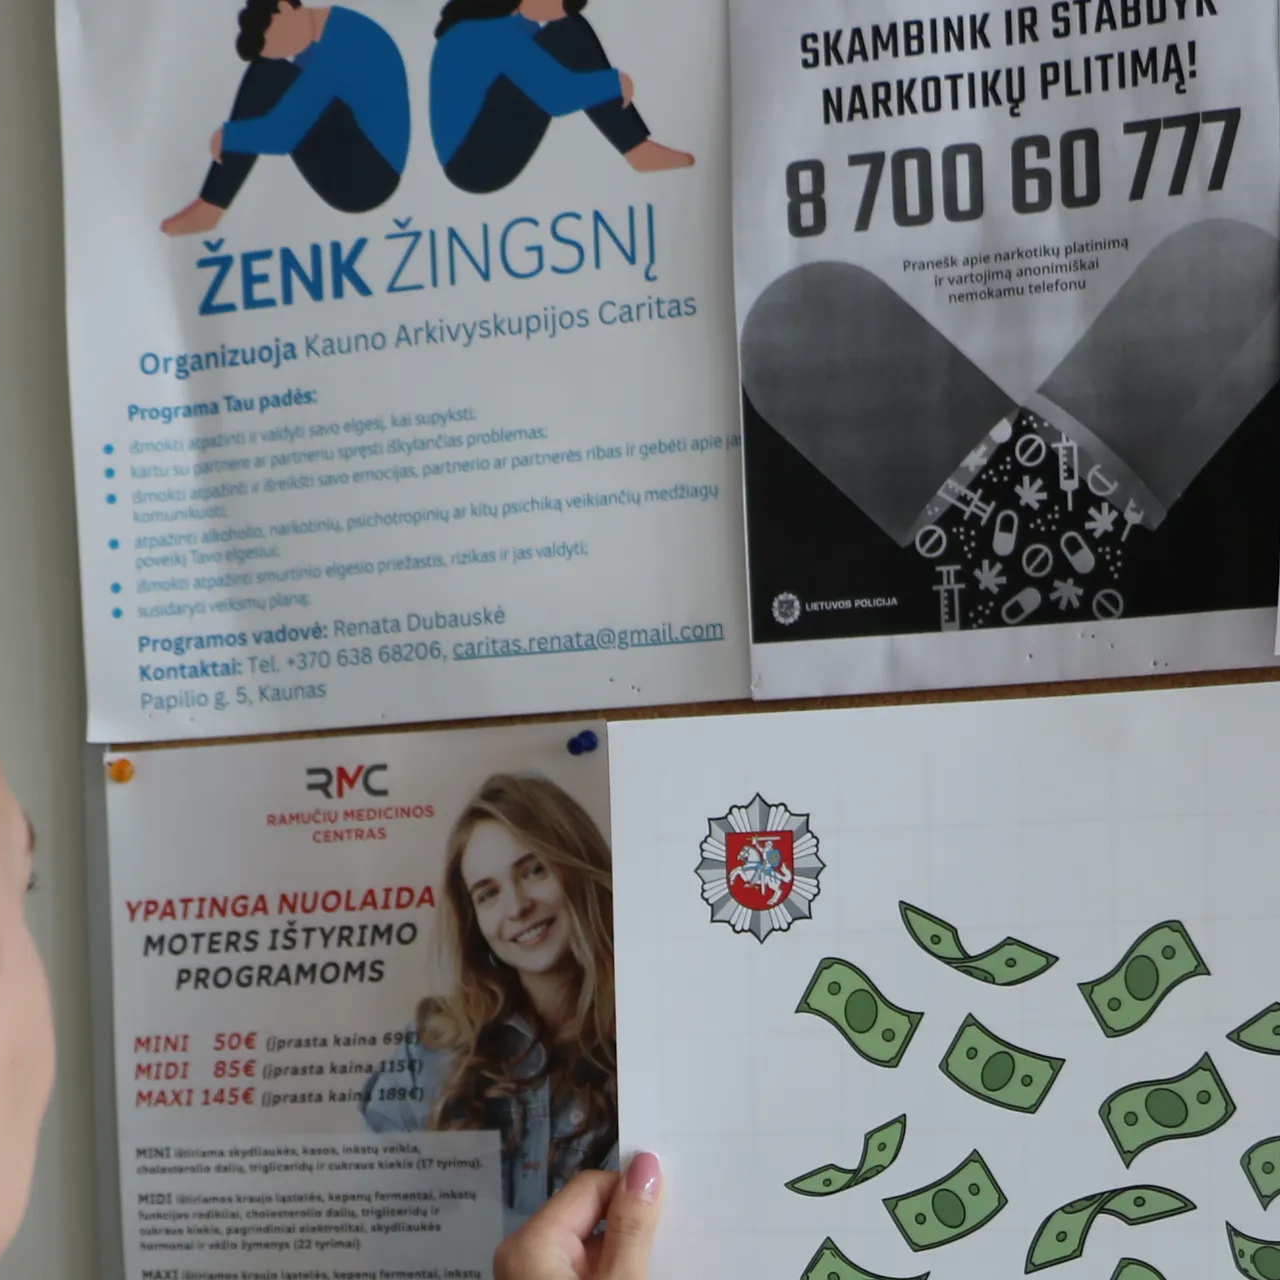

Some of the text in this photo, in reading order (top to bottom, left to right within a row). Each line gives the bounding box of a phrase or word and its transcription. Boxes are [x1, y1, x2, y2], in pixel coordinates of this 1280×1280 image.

[801, 6, 1039, 69] SKAMBINK IR
[823, 40, 1196, 124] NARKOTIKŲ PLITIMĄ!
[786, 107, 1241, 238] 8 700 60 777
[196, 203, 657, 316] ŽENK ŽINGSNĮ
[903, 238, 1129, 272] Pranešk apie narkotikų platinimą
[934, 257, 1099, 287] ir vartojimą anonimiškai
[949, 279, 1086, 303] nemokamu telefonu
[141, 296, 697, 380] Organizuoja Kauno Arkivyskupijos Caritas
[128, 388, 317, 421] Programa Tau padės:
[805, 597, 898, 612] LIETUVOS POLICIJA
[138, 606, 505, 656] Programos vadovė: Renata Dubauskė
[139, 620, 725, 681] Kontaktai: Tel. +370 638 68206, caritas.renata@gmail.com
[141, 690, 209, 713] Papilio
[259, 683, 326, 702] Kaunas
[306, 764, 389, 799] RMC
[267, 805, 435, 826] RAMUČIŲ MEDICINOS
[312, 827, 386, 843] CENTRAS
[127, 885, 436, 921] YPATINGA NUOLAIDA
[144, 920, 418, 956] MOTERS IŠTYRIMO
[177, 959, 385, 989] PROGRAMOMS
[134, 1032, 257, 1053] MINI 50€
[135, 1059, 256, 1080] MIDI 85€
[136, 1087, 255, 1106] MAXI 145€
